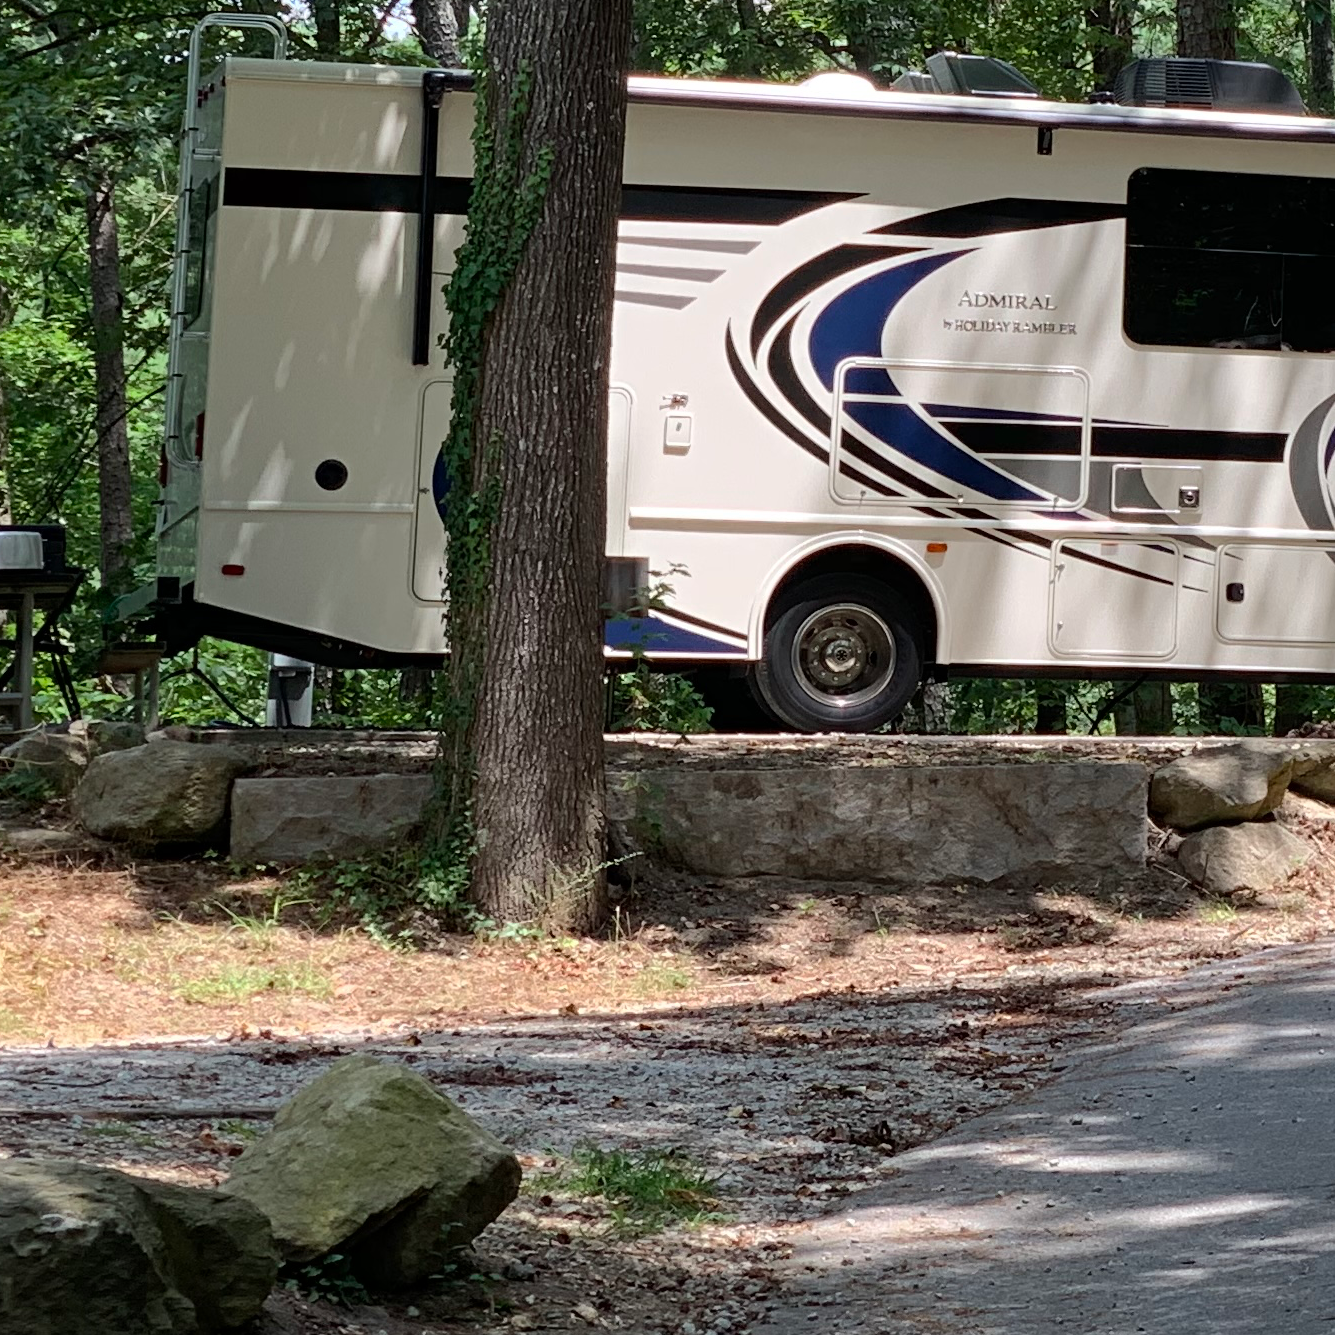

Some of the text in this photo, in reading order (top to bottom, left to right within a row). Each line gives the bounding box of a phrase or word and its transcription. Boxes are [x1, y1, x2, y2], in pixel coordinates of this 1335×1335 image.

[957, 290, 1058, 311] ADMIRAL
[954, 319, 1011, 333] HOLIDAY
[1012, 321, 1078, 336] RAMBLER
